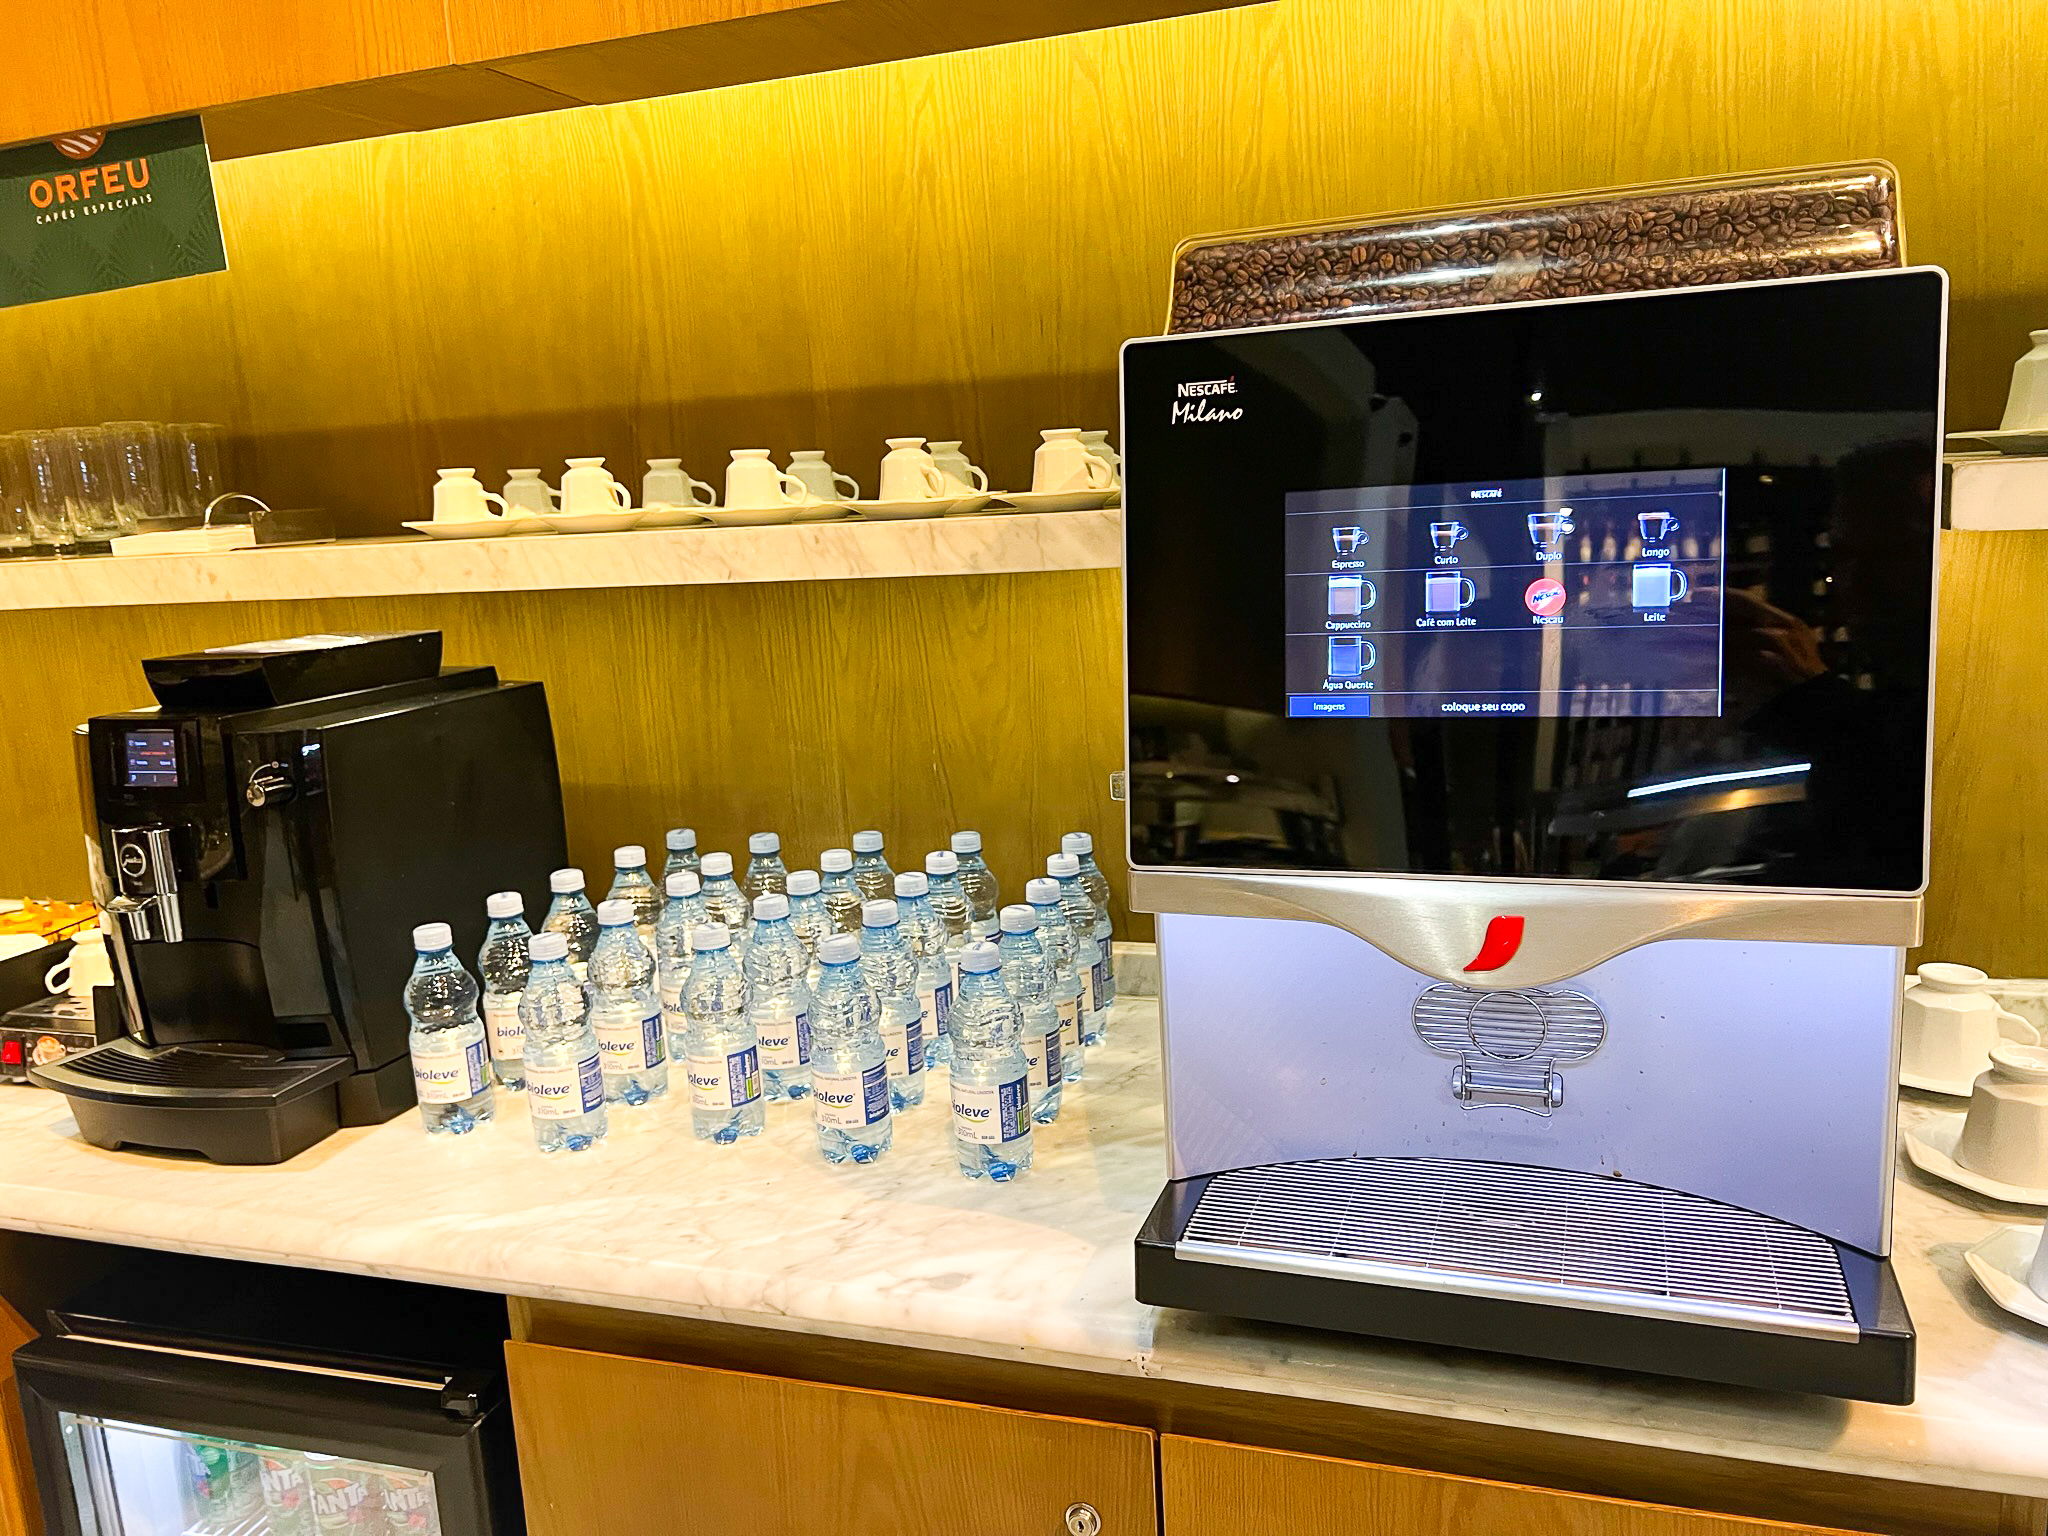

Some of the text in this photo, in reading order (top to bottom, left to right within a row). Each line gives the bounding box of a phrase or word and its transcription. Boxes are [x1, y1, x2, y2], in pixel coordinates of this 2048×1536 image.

[30, 158, 150, 209] ORFEU
[83, 193, 153, 216] ESPECIAIS
[1177, 375, 1236, 398] NESCAFÉ
[1171, 398, 1244, 425] Milano
[1535, 551, 1562, 562] Duplo
[1641, 547, 1670, 558] Longo
[1331, 559, 1365, 570] Espresso
[1434, 555, 1459, 565] Curto
[1416, 617, 1477, 628] Café com Leite
[1532, 615, 1564, 625] Nescau
[1643, 613, 1666, 622] Leite
[1325, 621, 1371, 631] Cappuccino
[1322, 680, 1374, 691] Água Quente
[1313, 702, 1346, 712] Imagens
[1441, 701, 1526, 713] coloque seu copo
[497, 1026, 524, 1037] biol
